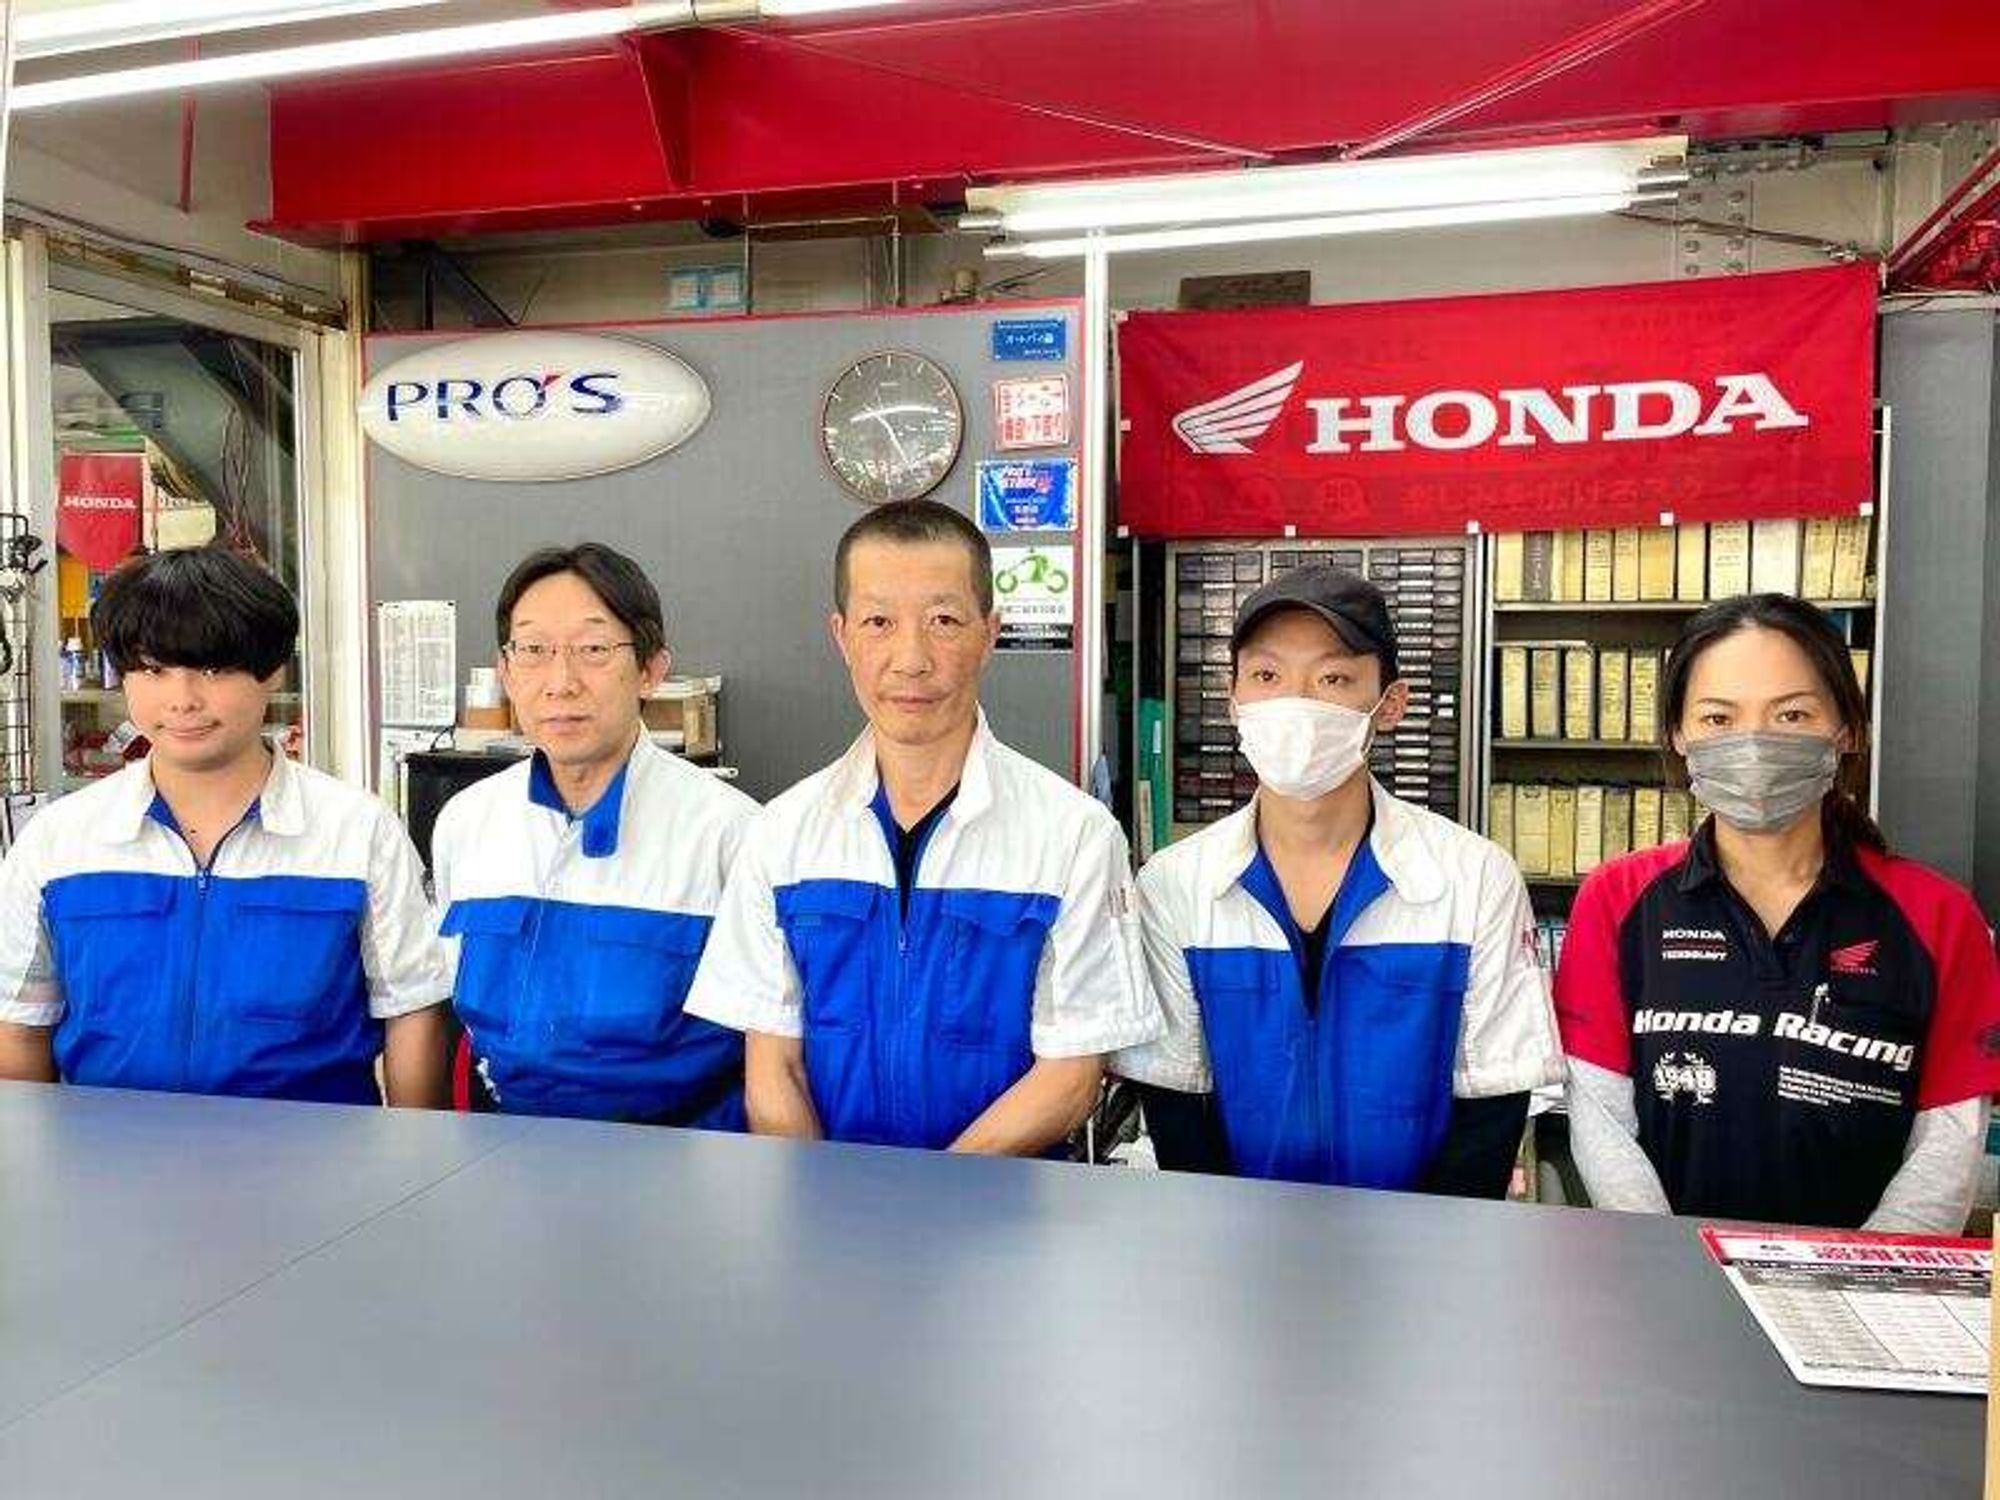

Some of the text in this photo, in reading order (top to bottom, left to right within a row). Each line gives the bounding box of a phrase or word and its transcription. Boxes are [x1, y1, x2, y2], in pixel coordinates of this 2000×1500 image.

[1305, 372, 1809, 455] HONDA
[63, 494, 137, 510] HONDA
[1662, 929, 1726, 941] HONDA
[1633, 1008, 1915, 1071] Honda Racing
